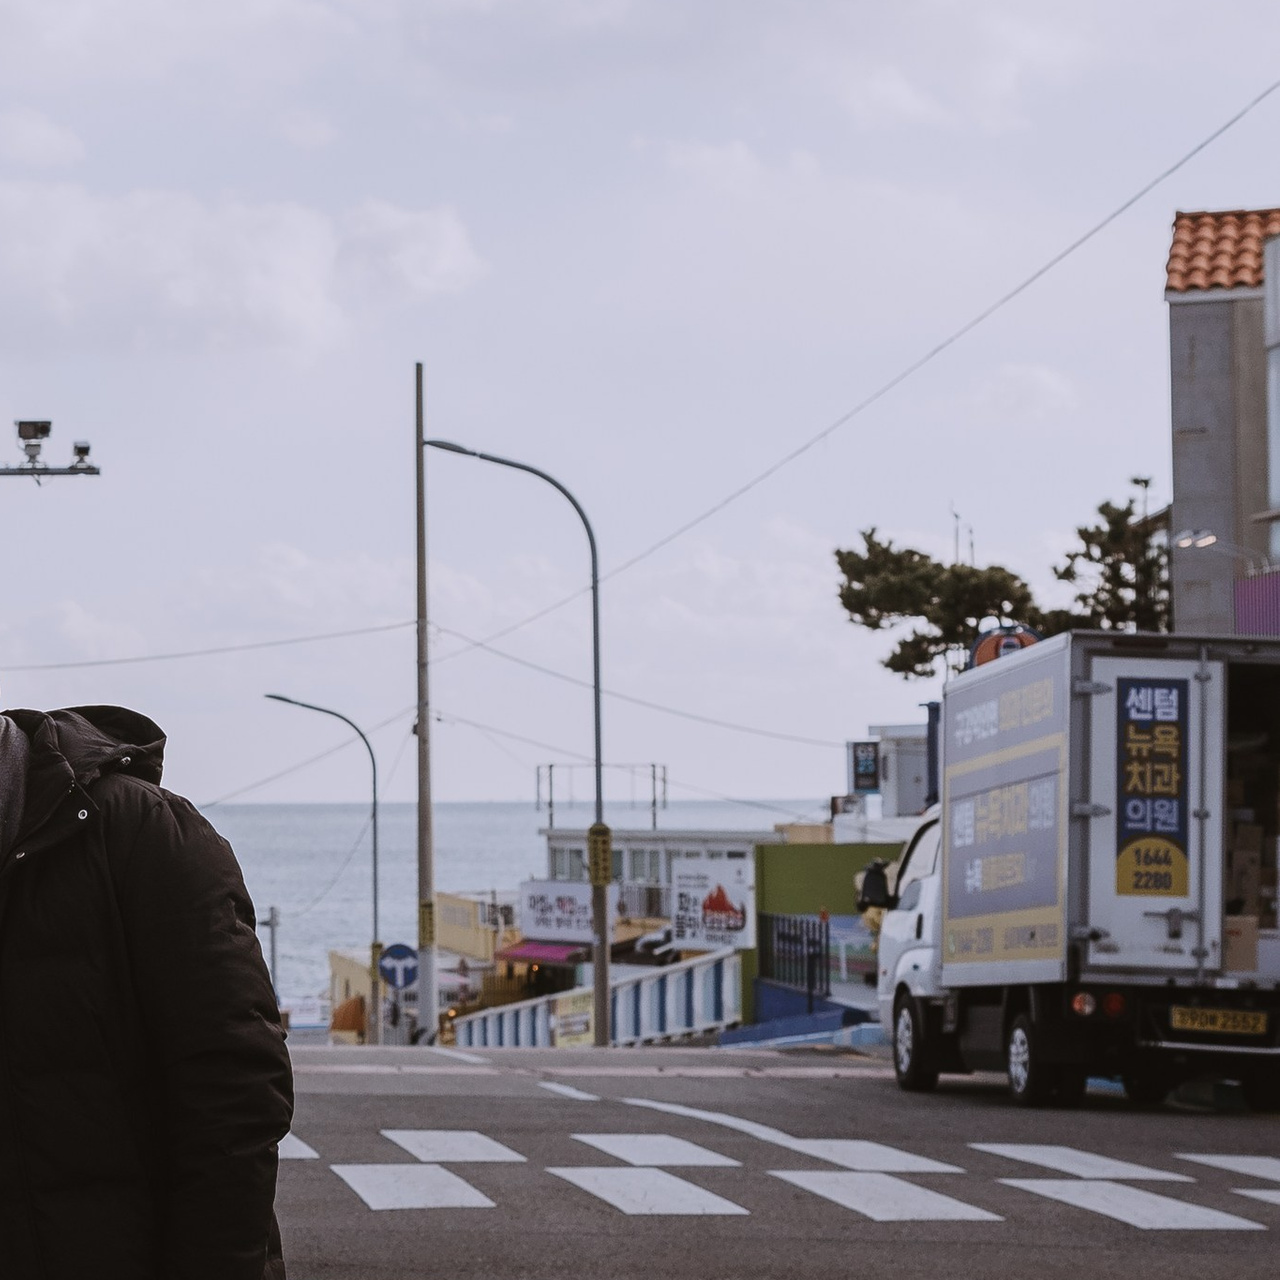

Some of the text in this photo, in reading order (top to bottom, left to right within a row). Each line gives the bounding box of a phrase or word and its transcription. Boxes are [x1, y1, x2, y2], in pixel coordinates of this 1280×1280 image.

[1126, 687, 1179, 721] 센텀
[1126, 723, 1180, 758] 뉴욕
[1125, 761, 1180, 795] 치과
[1125, 798, 1179, 832] 의원
[1134, 848, 1173, 866] 1644
